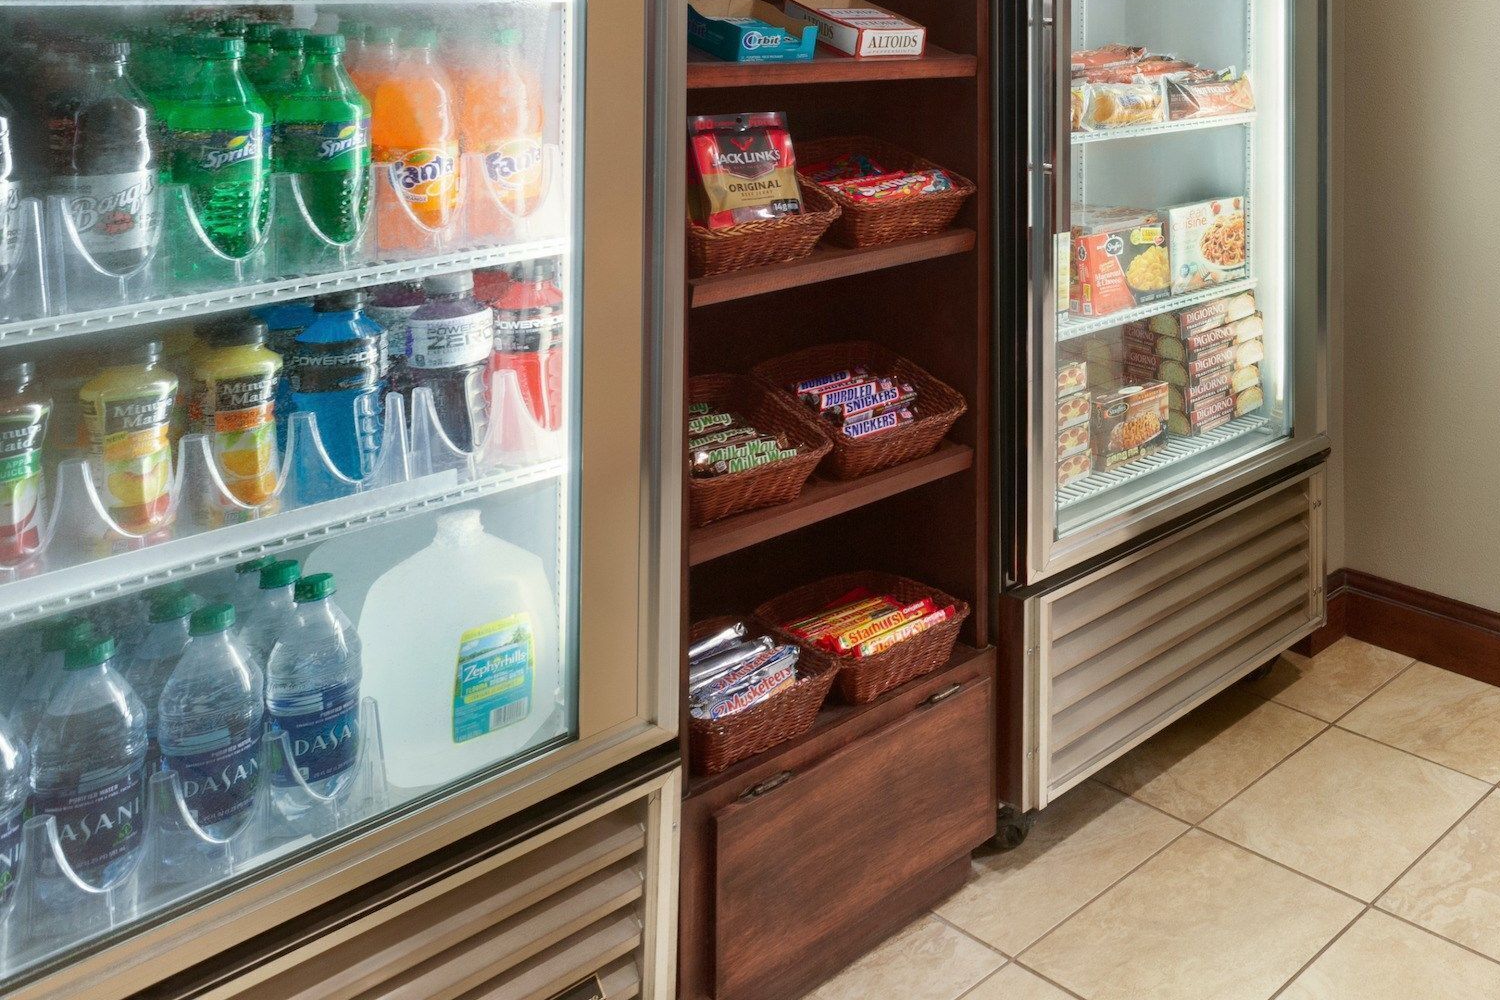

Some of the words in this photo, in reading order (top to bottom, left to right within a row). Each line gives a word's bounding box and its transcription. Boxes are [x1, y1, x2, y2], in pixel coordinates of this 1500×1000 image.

[742, 31, 782, 51] Orbit
[867, 34, 918, 49] ALTOIDS
[711, 152, 745, 167] JACK
[728, 179, 782, 193] ORIGINAL
[1187, 303, 1224, 323] DIGIORNO
[1194, 327, 1232, 348] DIGIORNO
[1195, 348, 1232, 371] DIGIORNO
[825, 384, 872, 407] HURDLED
[846, 388, 898, 413] SNICKERS
[1196, 397, 1233, 421] DIGIORNO
[844, 413, 895, 437] SNICKERS
[849, 609, 905, 644] Starburst
[902, 601, 925, 614] Original
[463, 649, 527, 683] Zephyrhills
[60, 796, 139, 844] ASANI
